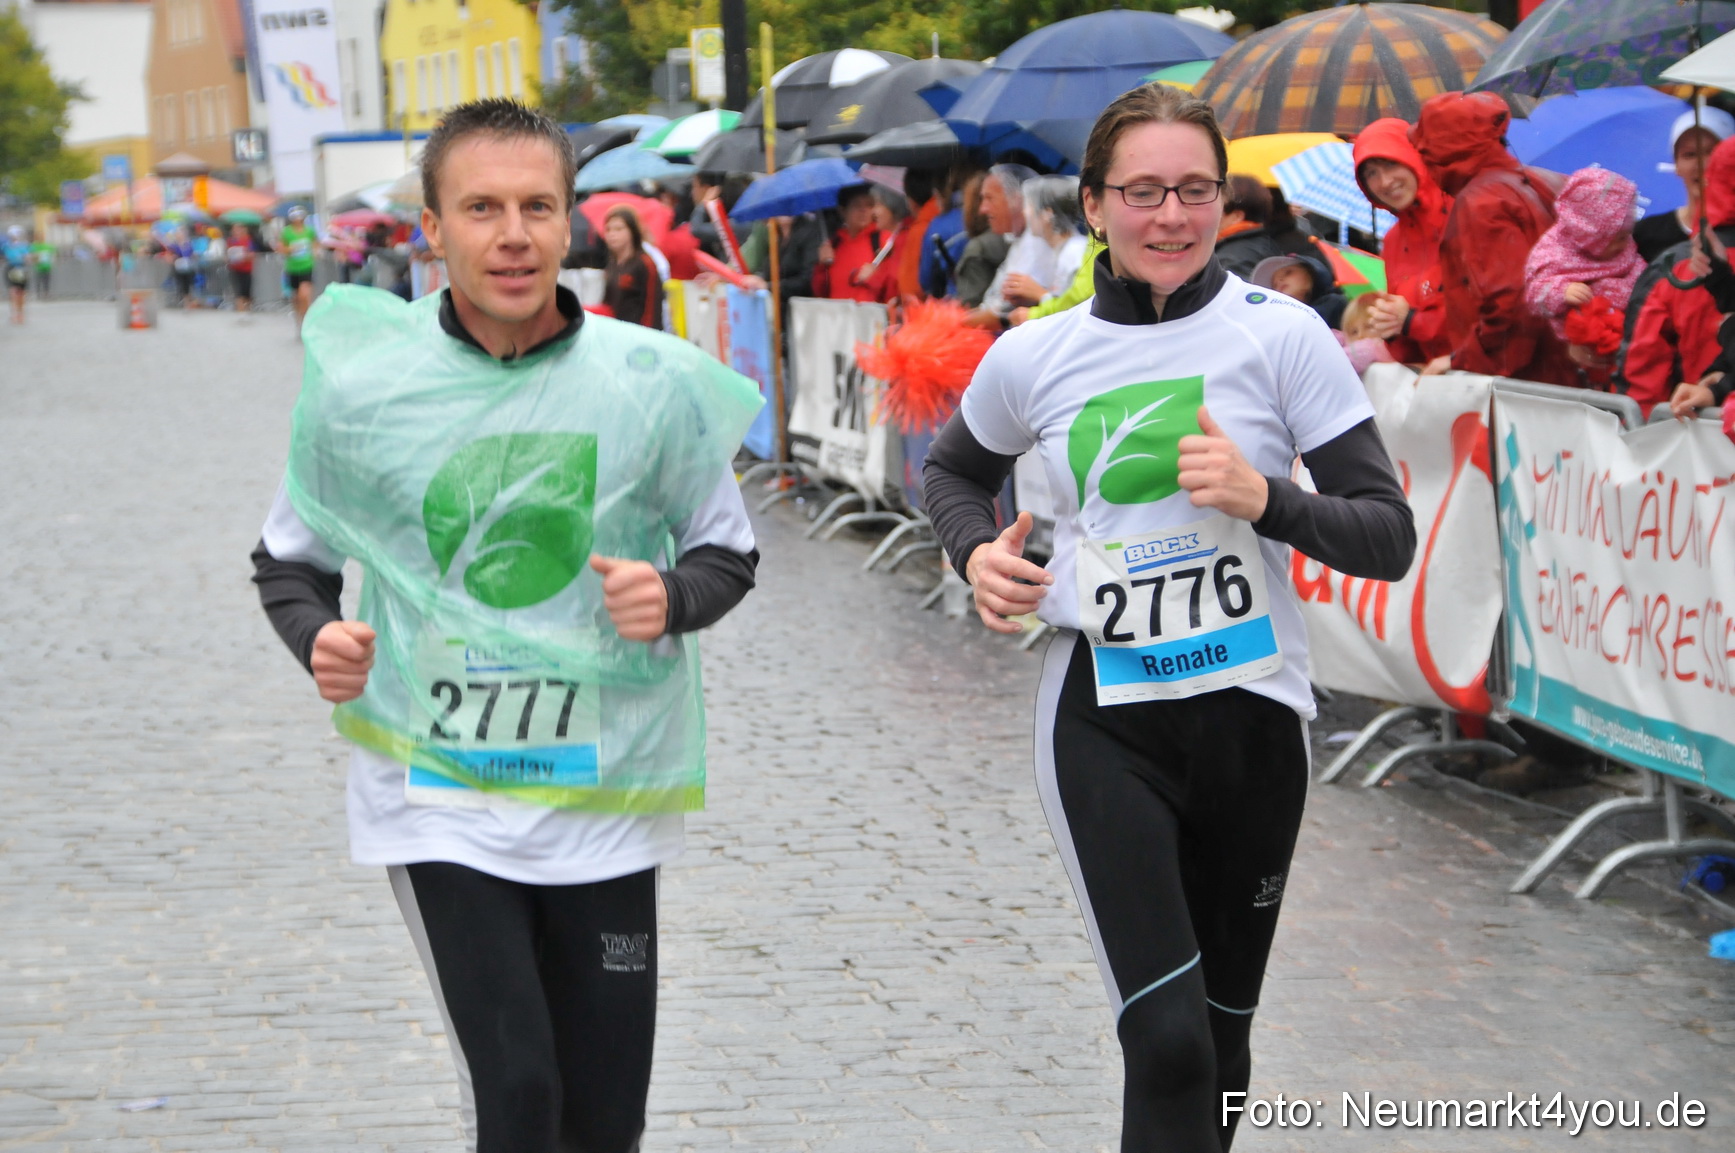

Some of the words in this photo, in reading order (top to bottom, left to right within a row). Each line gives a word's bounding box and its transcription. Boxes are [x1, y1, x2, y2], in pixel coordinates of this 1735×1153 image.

[1124, 533, 1199, 563] BOCK
[1095, 554, 1253, 643] 2776
[1142, 643, 1229, 677] Renate
[429, 679, 580, 742] 2777
[456, 756, 554, 780] adislav
